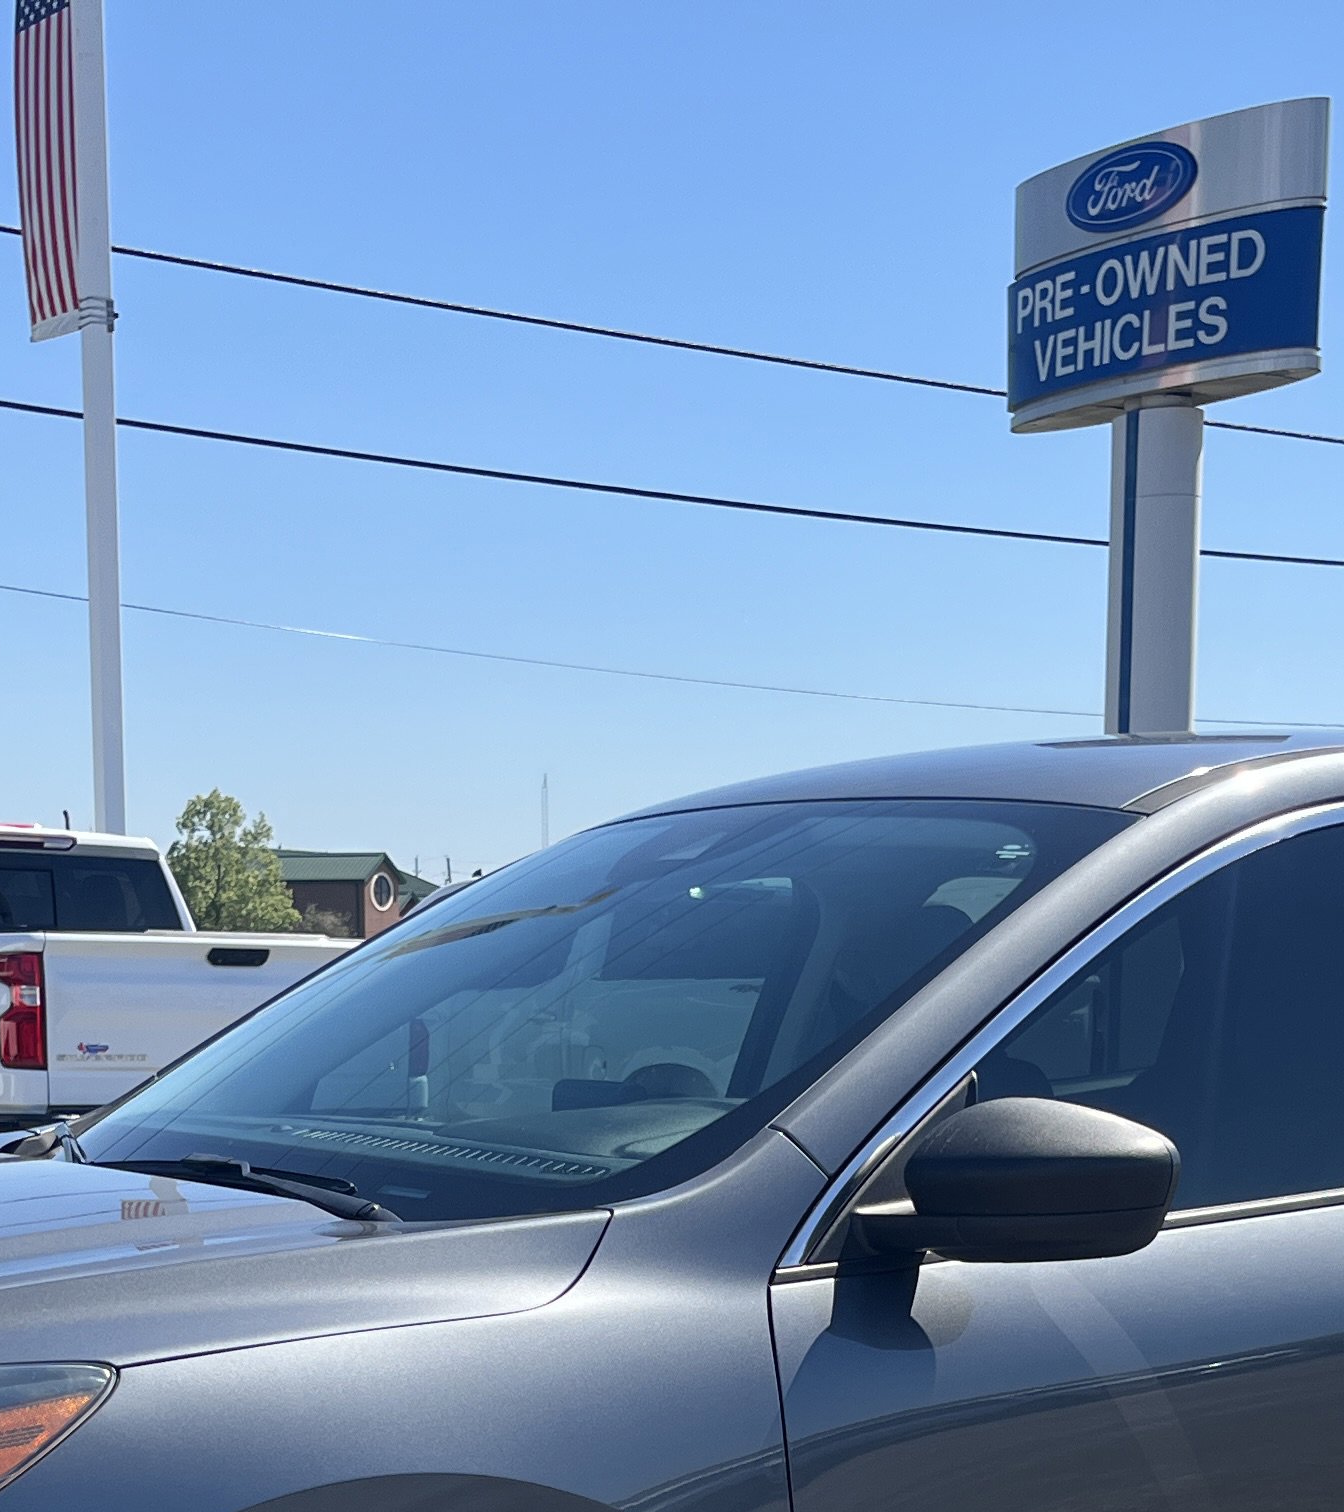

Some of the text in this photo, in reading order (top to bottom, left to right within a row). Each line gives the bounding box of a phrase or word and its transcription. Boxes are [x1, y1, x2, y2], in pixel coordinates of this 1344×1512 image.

[1087, 160, 1161, 217] Ford
[1016, 229, 1266, 334] PRE-OWNED
[1034, 296, 1229, 382] VEHICLES
